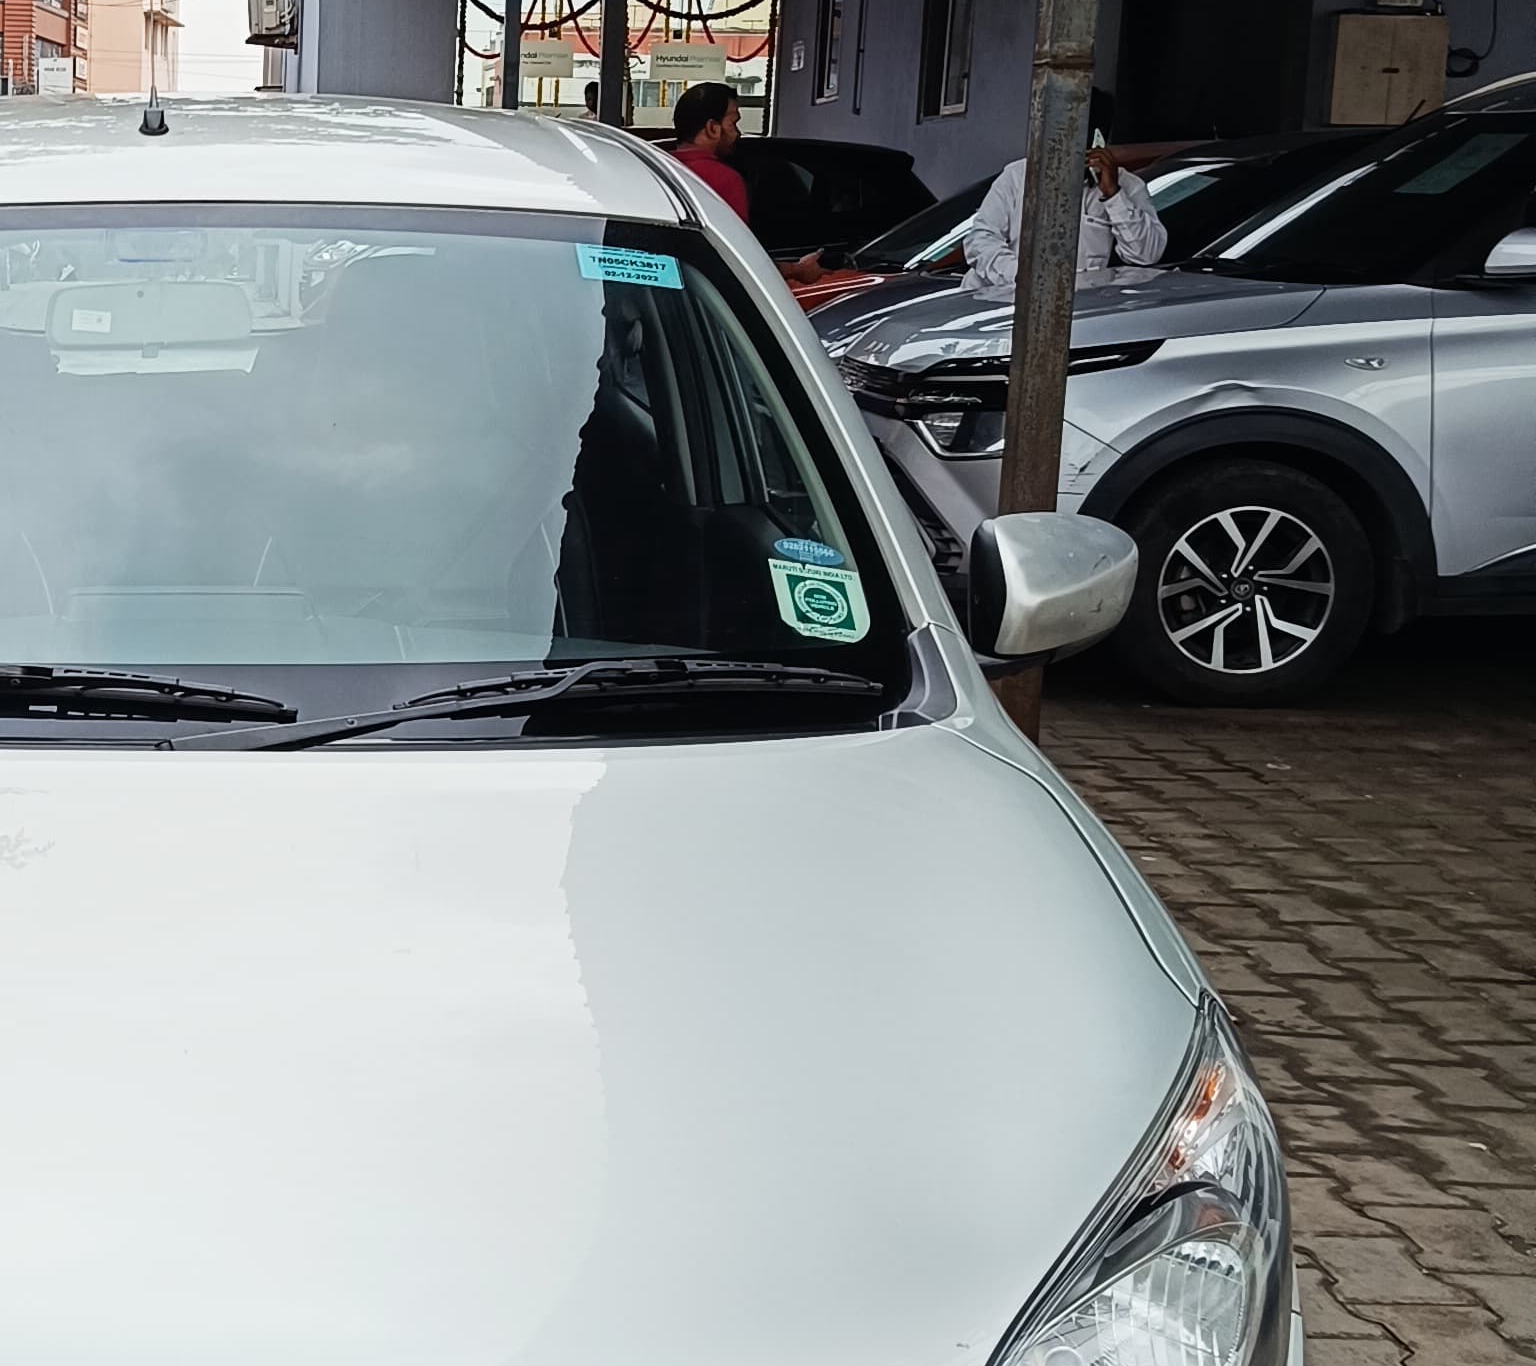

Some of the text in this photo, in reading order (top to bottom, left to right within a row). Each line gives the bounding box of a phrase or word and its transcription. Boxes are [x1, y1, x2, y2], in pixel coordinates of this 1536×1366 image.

[655, 54, 689, 63] Hyundai
[772, 563, 798, 573] MARUTI
[798, 566, 821, 576] SZUKI
